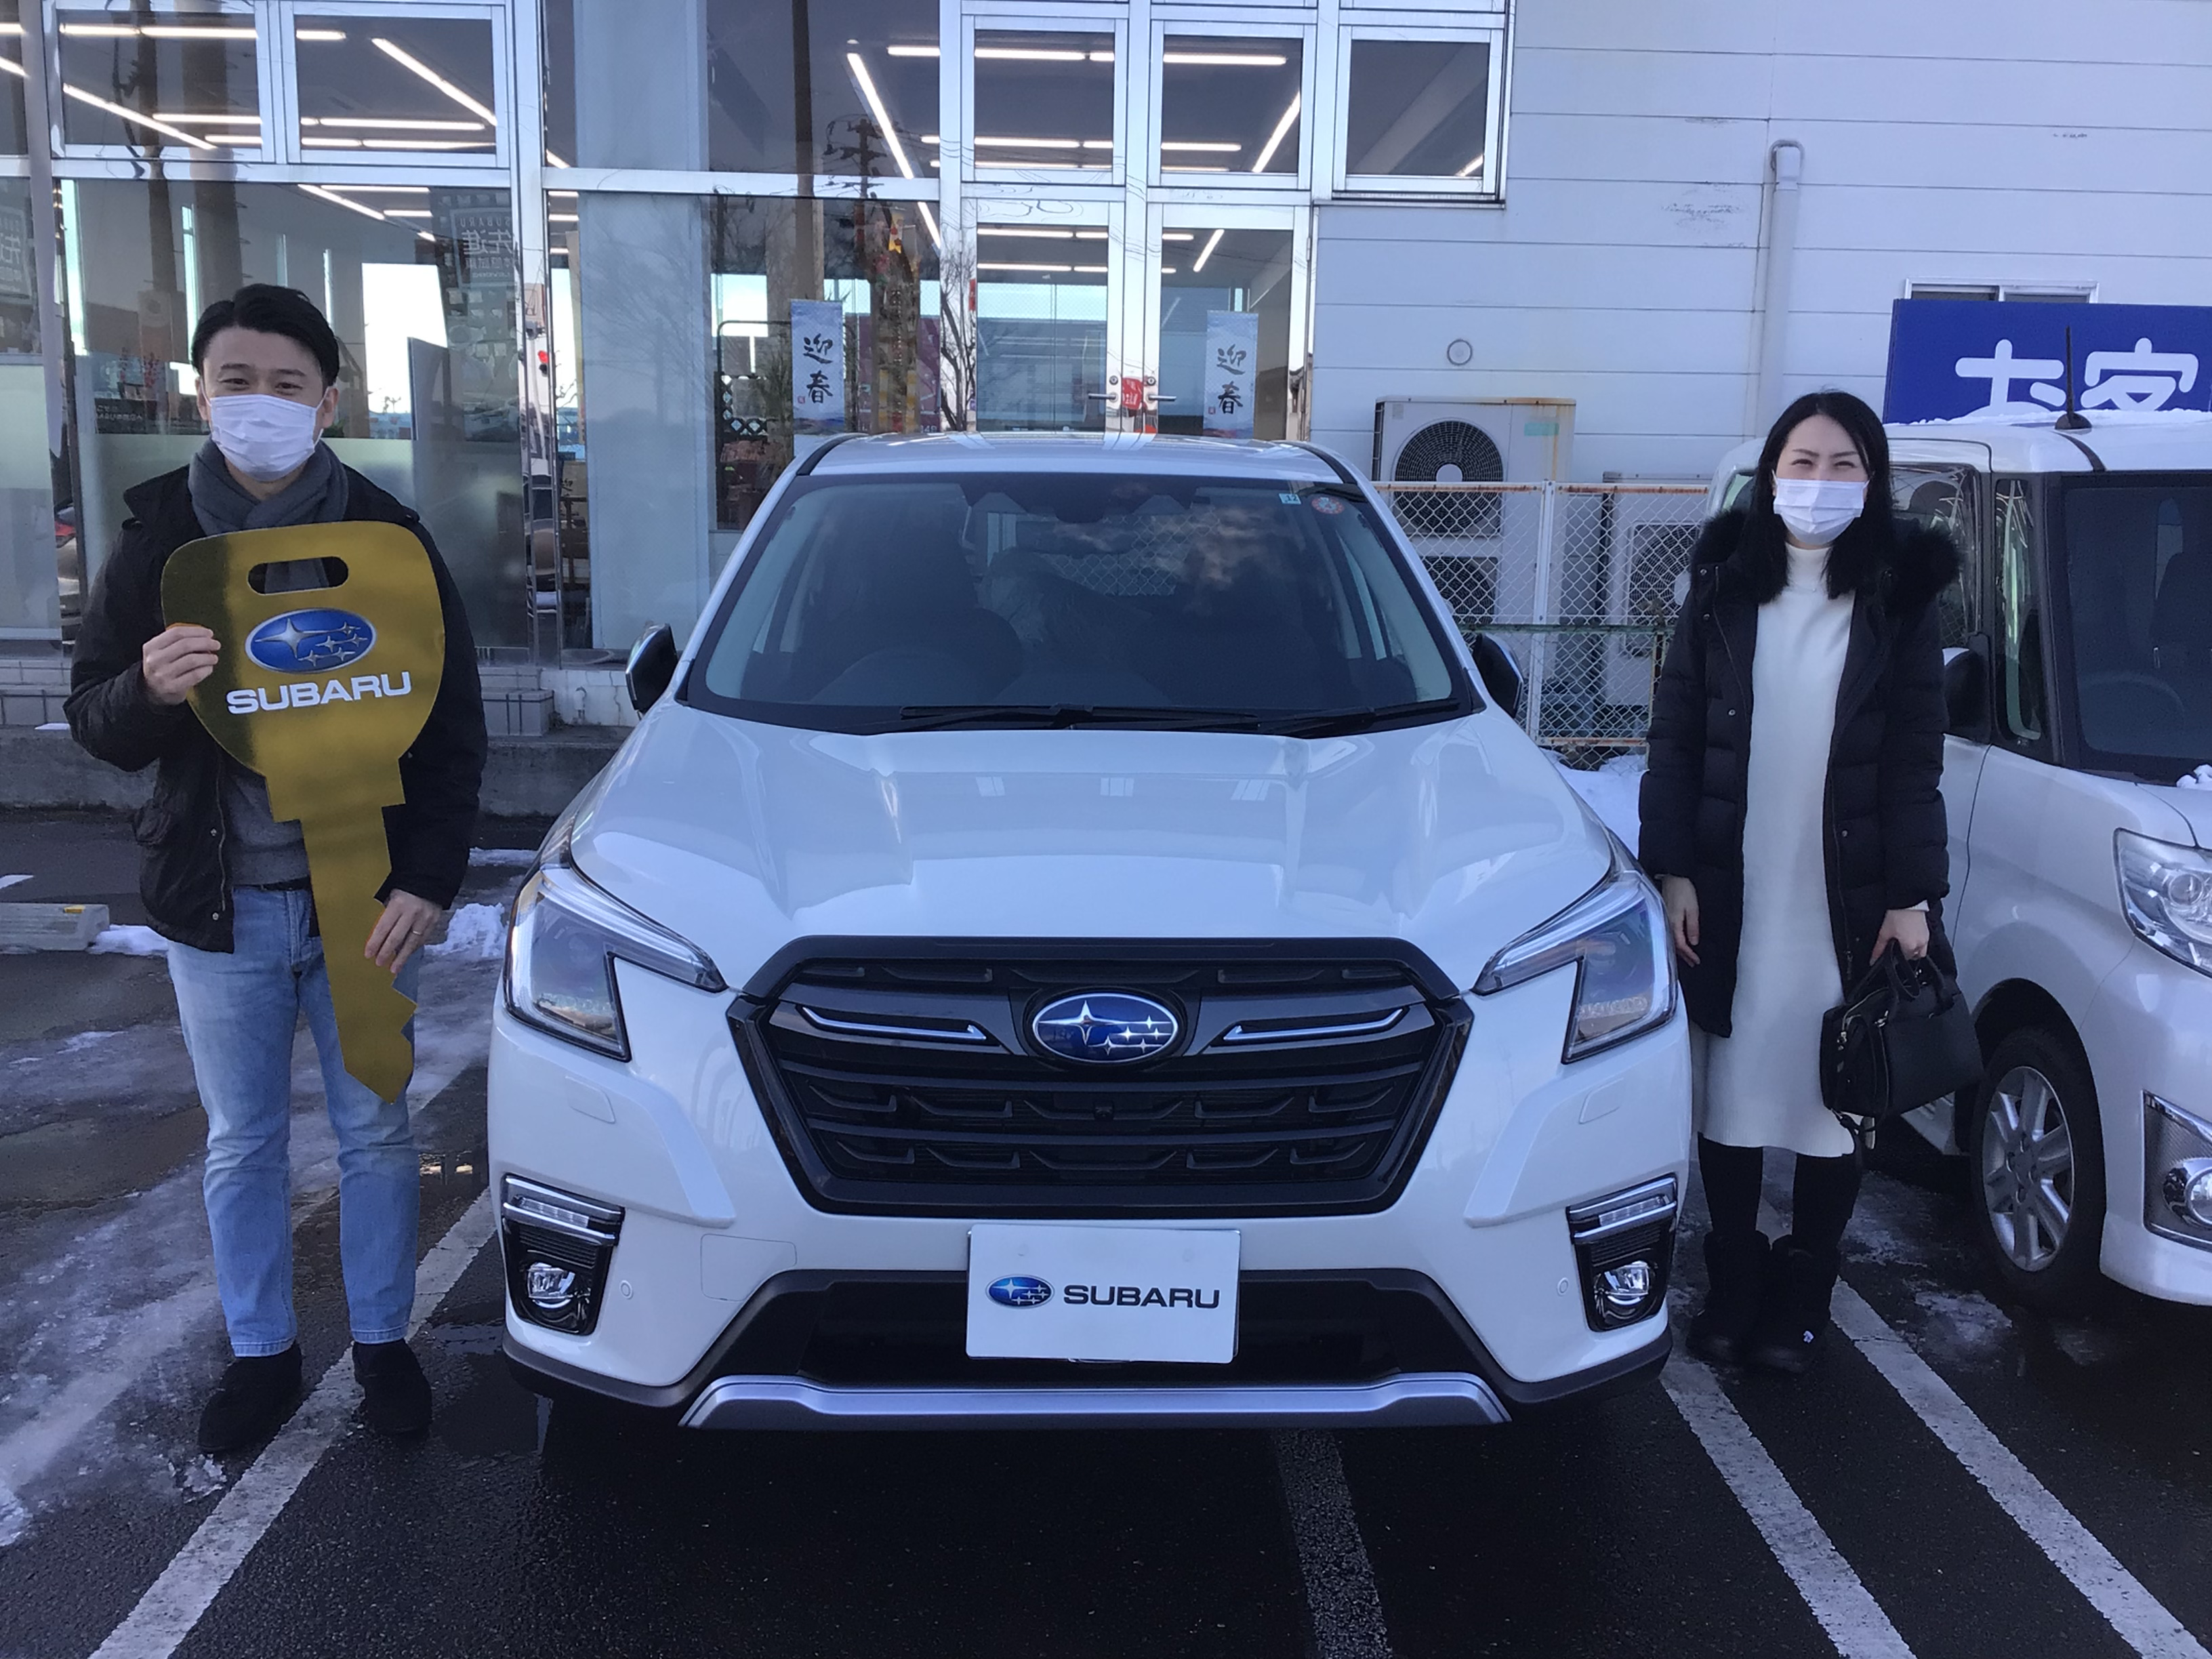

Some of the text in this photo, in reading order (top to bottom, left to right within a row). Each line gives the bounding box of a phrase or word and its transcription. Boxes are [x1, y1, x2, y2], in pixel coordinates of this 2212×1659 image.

[803, 333, 834, 404] 迎春
[1216, 344, 1247, 415] 迎春
[226, 672, 412, 715] SUBARU
[1063, 1285, 1220, 1309] SUBARU
